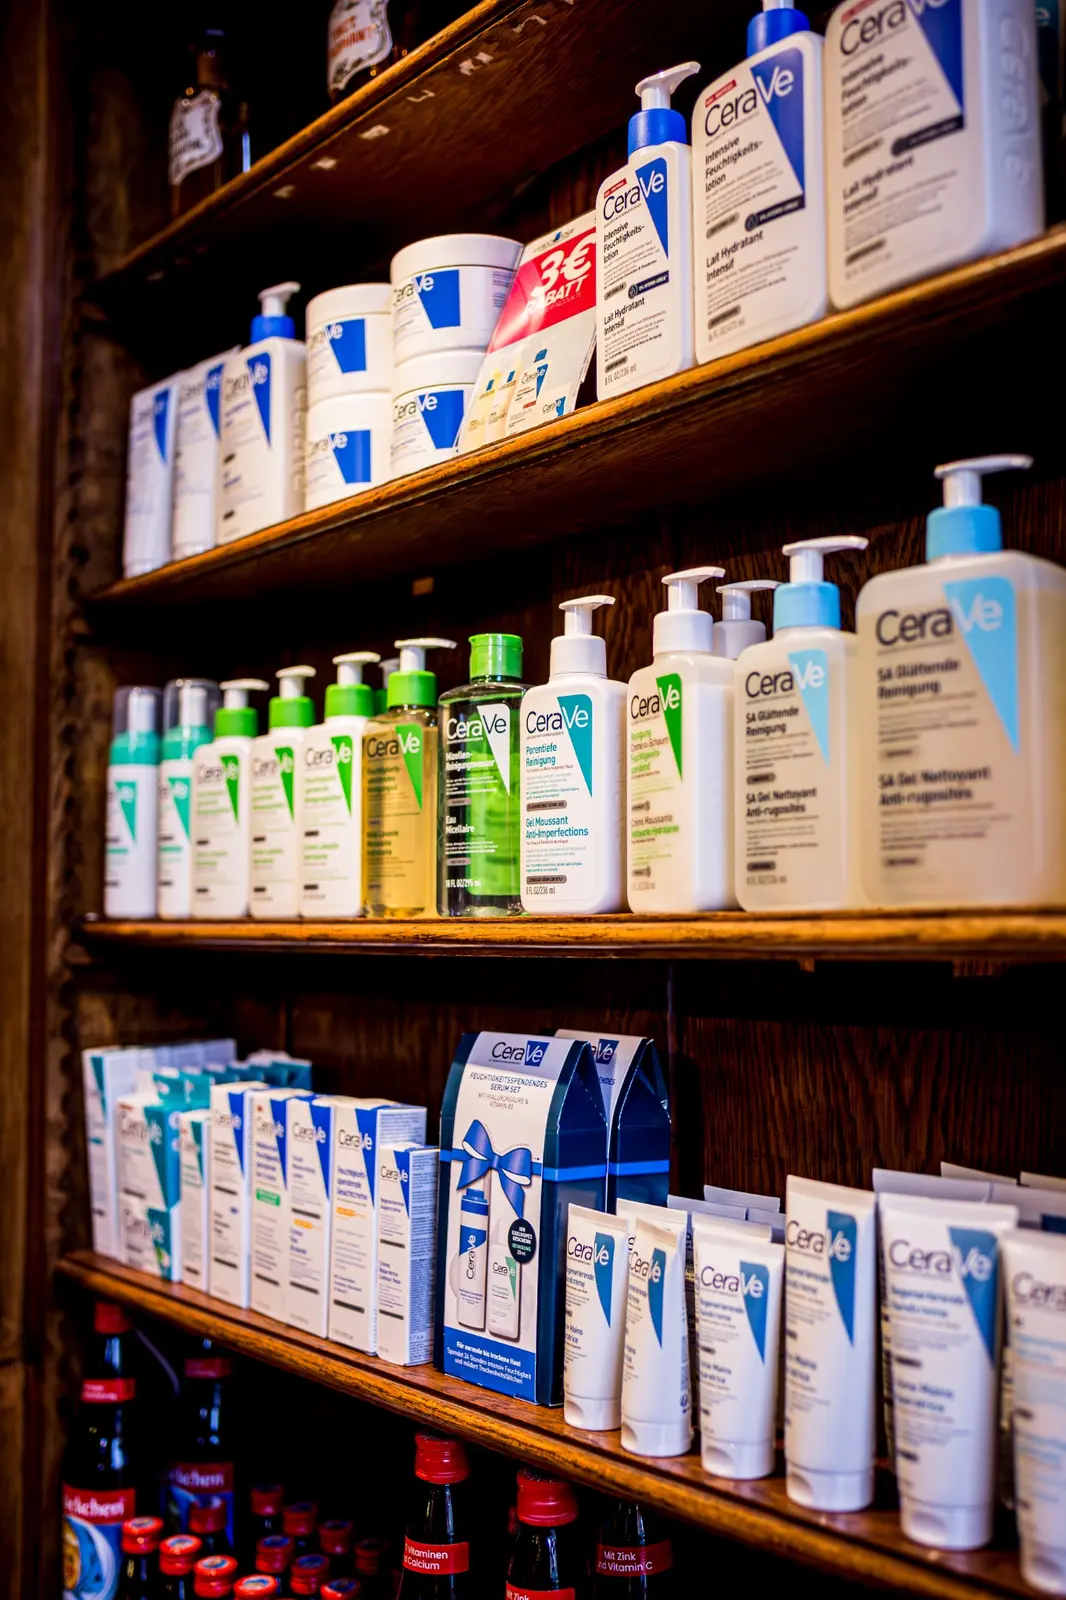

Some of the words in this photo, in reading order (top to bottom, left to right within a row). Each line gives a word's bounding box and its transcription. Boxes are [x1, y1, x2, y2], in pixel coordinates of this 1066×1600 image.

[705, 65, 794, 137] CeraVe
[705, 137, 740, 165] Intensive
[705, 140, 763, 180] Feuchtigkeits-
[705, 174, 727, 193] lotion
[603, 171, 665, 221] CeraVe
[604, 222, 629, 243] Intensive
[604, 225, 646, 254] Feuchtigkeits-
[604, 249, 619, 265] lotion
[706, 252, 719, 269] Lait
[721, 230, 763, 258] Hydratant
[531, 232, 597, 296] 3€
[706, 258, 735, 282] Intensif
[523, 274, 590, 314] RABATT
[604, 312, 614, 325] Lait
[615, 297, 645, 319] Hydratant
[604, 317, 624, 336] Intensif
[875, 592, 1003, 647] CeraVe
[745, 660, 825, 698] CeraVe
[630, 684, 681, 720] CeraVe
[525, 705, 589, 735] CeraVe
[745, 713, 756, 724] SA
[758, 706, 800, 721] Glättende
[445, 713, 507, 741] CeraVe
[745, 723, 786, 738] Reinigung
[305, 741, 352, 768] CeraVe
[366, 731, 421, 758] CeraVe
[526, 742, 557, 756] Porentiefe
[526, 756, 556, 768] Reinigung
[746, 793, 756, 804] SA
[757, 792, 770, 802] Gel
[773, 788, 817, 803] Nettoyant
[446, 815, 457, 825] Eau
[446, 824, 475, 835] Micellaire
[526, 818, 534, 828] Gel
[535, 816, 568, 827] Moussant
[526, 827, 589, 840] Anti-Imperfections
[491, 1041, 544, 1063] CeraVe
[470, 1072, 548, 1089] FEUCHTIGKEITSSPENDENDES
[490, 1083, 510, 1093] SERUM
[510, 1086, 521, 1094] SET
[293, 1121, 326, 1144] CeraVe
[337, 1129, 372, 1151] CeraVe
[380, 1165, 409, 1183] CeraVe
[567, 1236, 609, 1266] CeraVe
[787, 1220, 851, 1262] CeraVe
[466, 1235, 476, 1280] CeraVe
[630, 1251, 662, 1284] CeraVe
[888, 1238, 993, 1283] CeraVe
[492, 1262, 516, 1277] CeraVe
[700, 1266, 764, 1299] CeraVe
[447, 1347, 464, 1358] Spendet
[464, 1352, 470, 1360] 24
[470, 1354, 487, 1365] Stunden
[488, 1360, 504, 1370] intensiv
[504, 1366, 532, 1381] Feuchtigkeit
[456, 1341, 464, 1349] Für
[464, 1345, 483, 1355] normale
[490, 1352, 510, 1365] trockene
[510, 1358, 521, 1367] Haut
[463, 1360, 478, 1370] mildert
[408, 1545, 448, 1559] Vitaminen
[408, 1557, 440, 1570] Calcium
[604, 1550, 615, 1561] Mit
[617, 1552, 636, 1561] Zink
[607, 1562, 643, 1572] Vitamin
[646, 1561, 653, 1570] C
